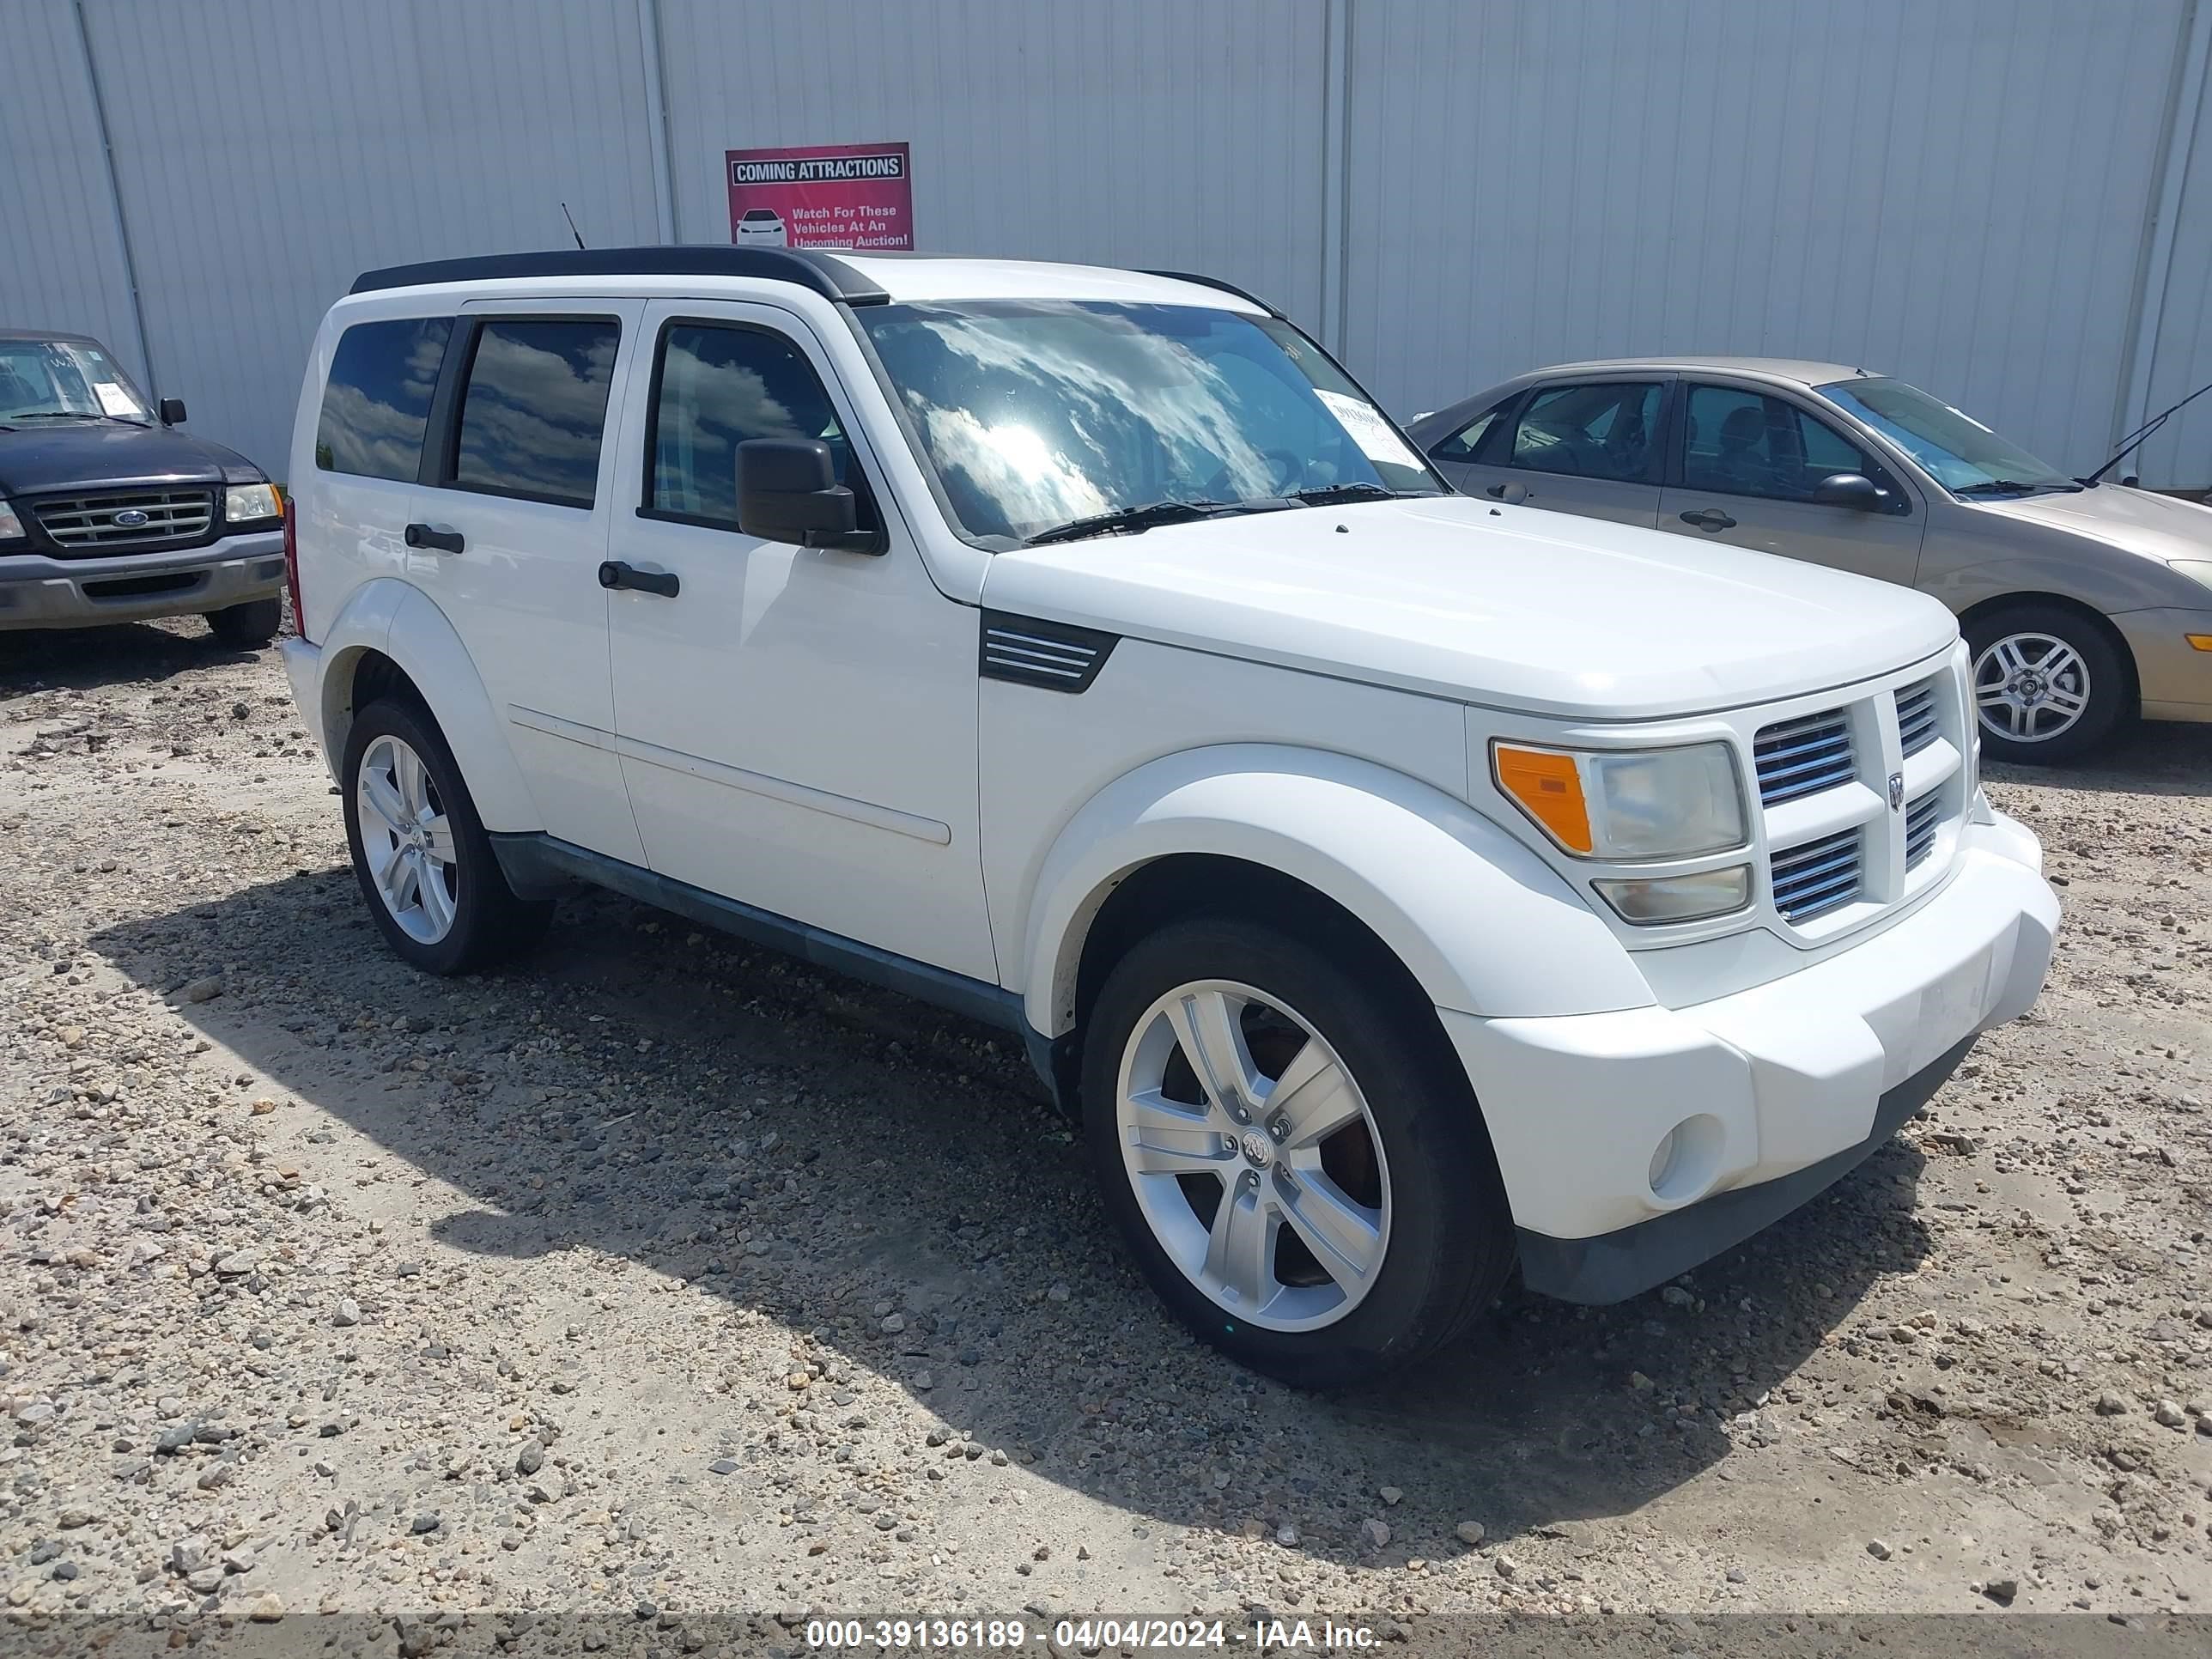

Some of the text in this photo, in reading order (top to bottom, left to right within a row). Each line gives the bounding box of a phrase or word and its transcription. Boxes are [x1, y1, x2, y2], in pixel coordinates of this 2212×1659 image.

[737, 158, 899, 181] COMING ATTRACTIONS
[793, 206, 896, 220] Watch For These
[793, 220, 886, 234] Vehicles At An
[793, 234, 908, 248] Upcoming Auction!
